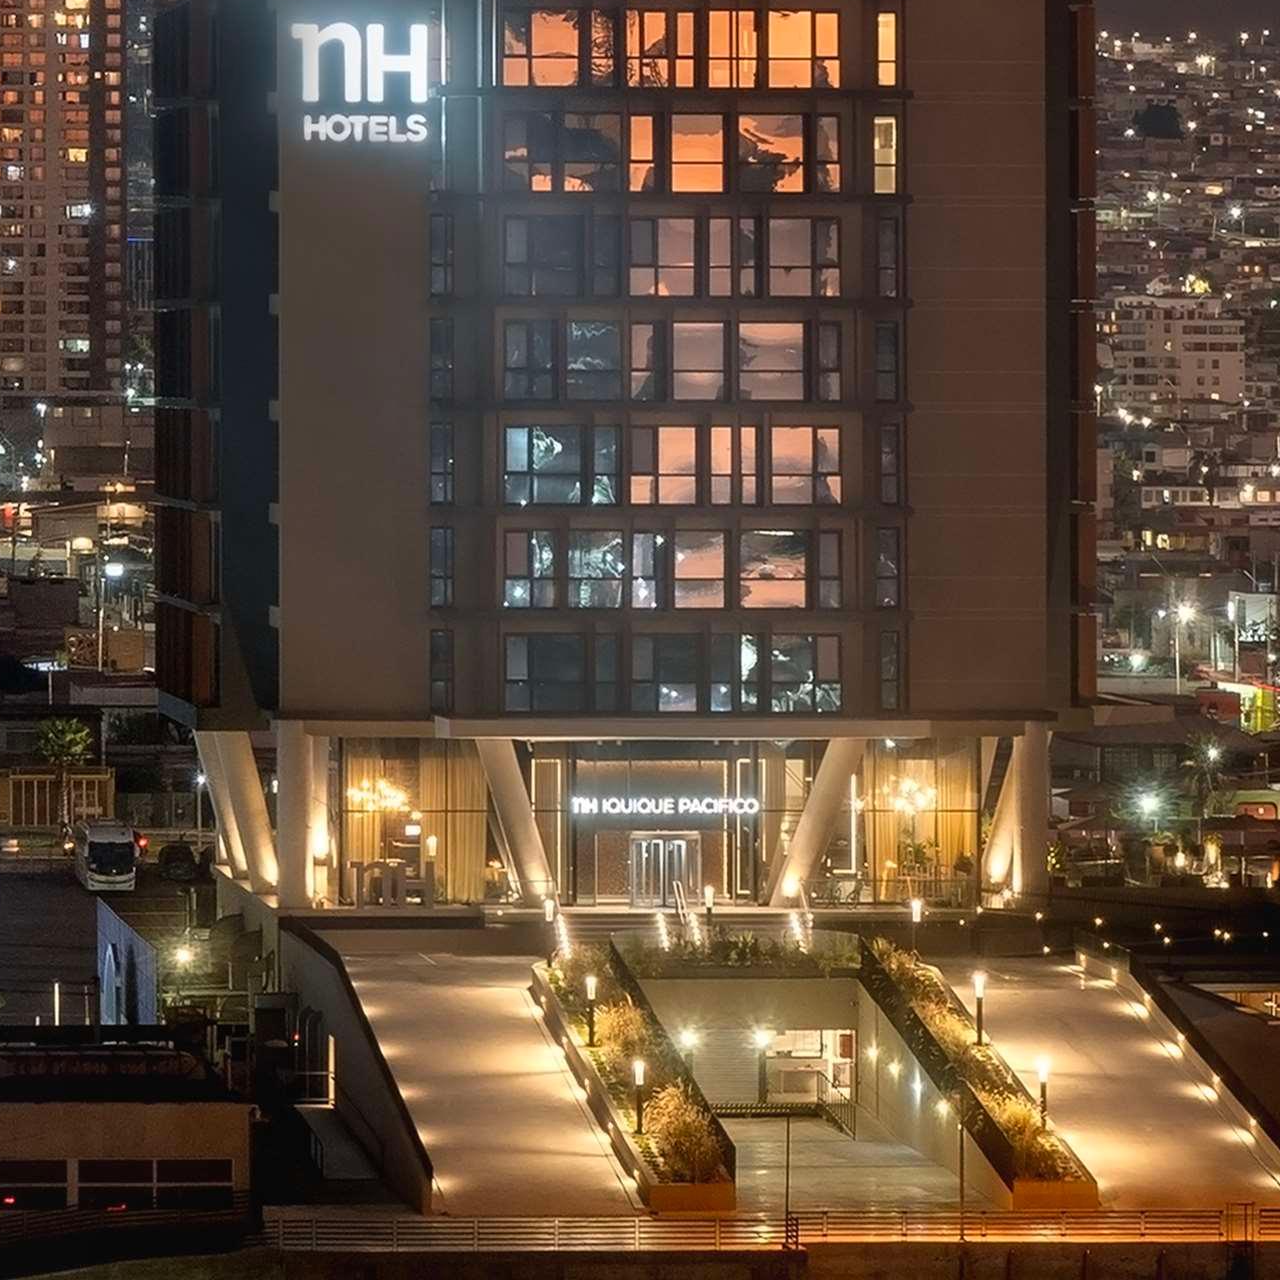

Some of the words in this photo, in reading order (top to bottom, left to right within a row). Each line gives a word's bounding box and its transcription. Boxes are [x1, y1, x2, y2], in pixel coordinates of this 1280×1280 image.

[303, 114, 428, 142] HOTELS
[602, 797, 676, 814] IQUIQUE
[678, 797, 760, 814] PACIFICO
